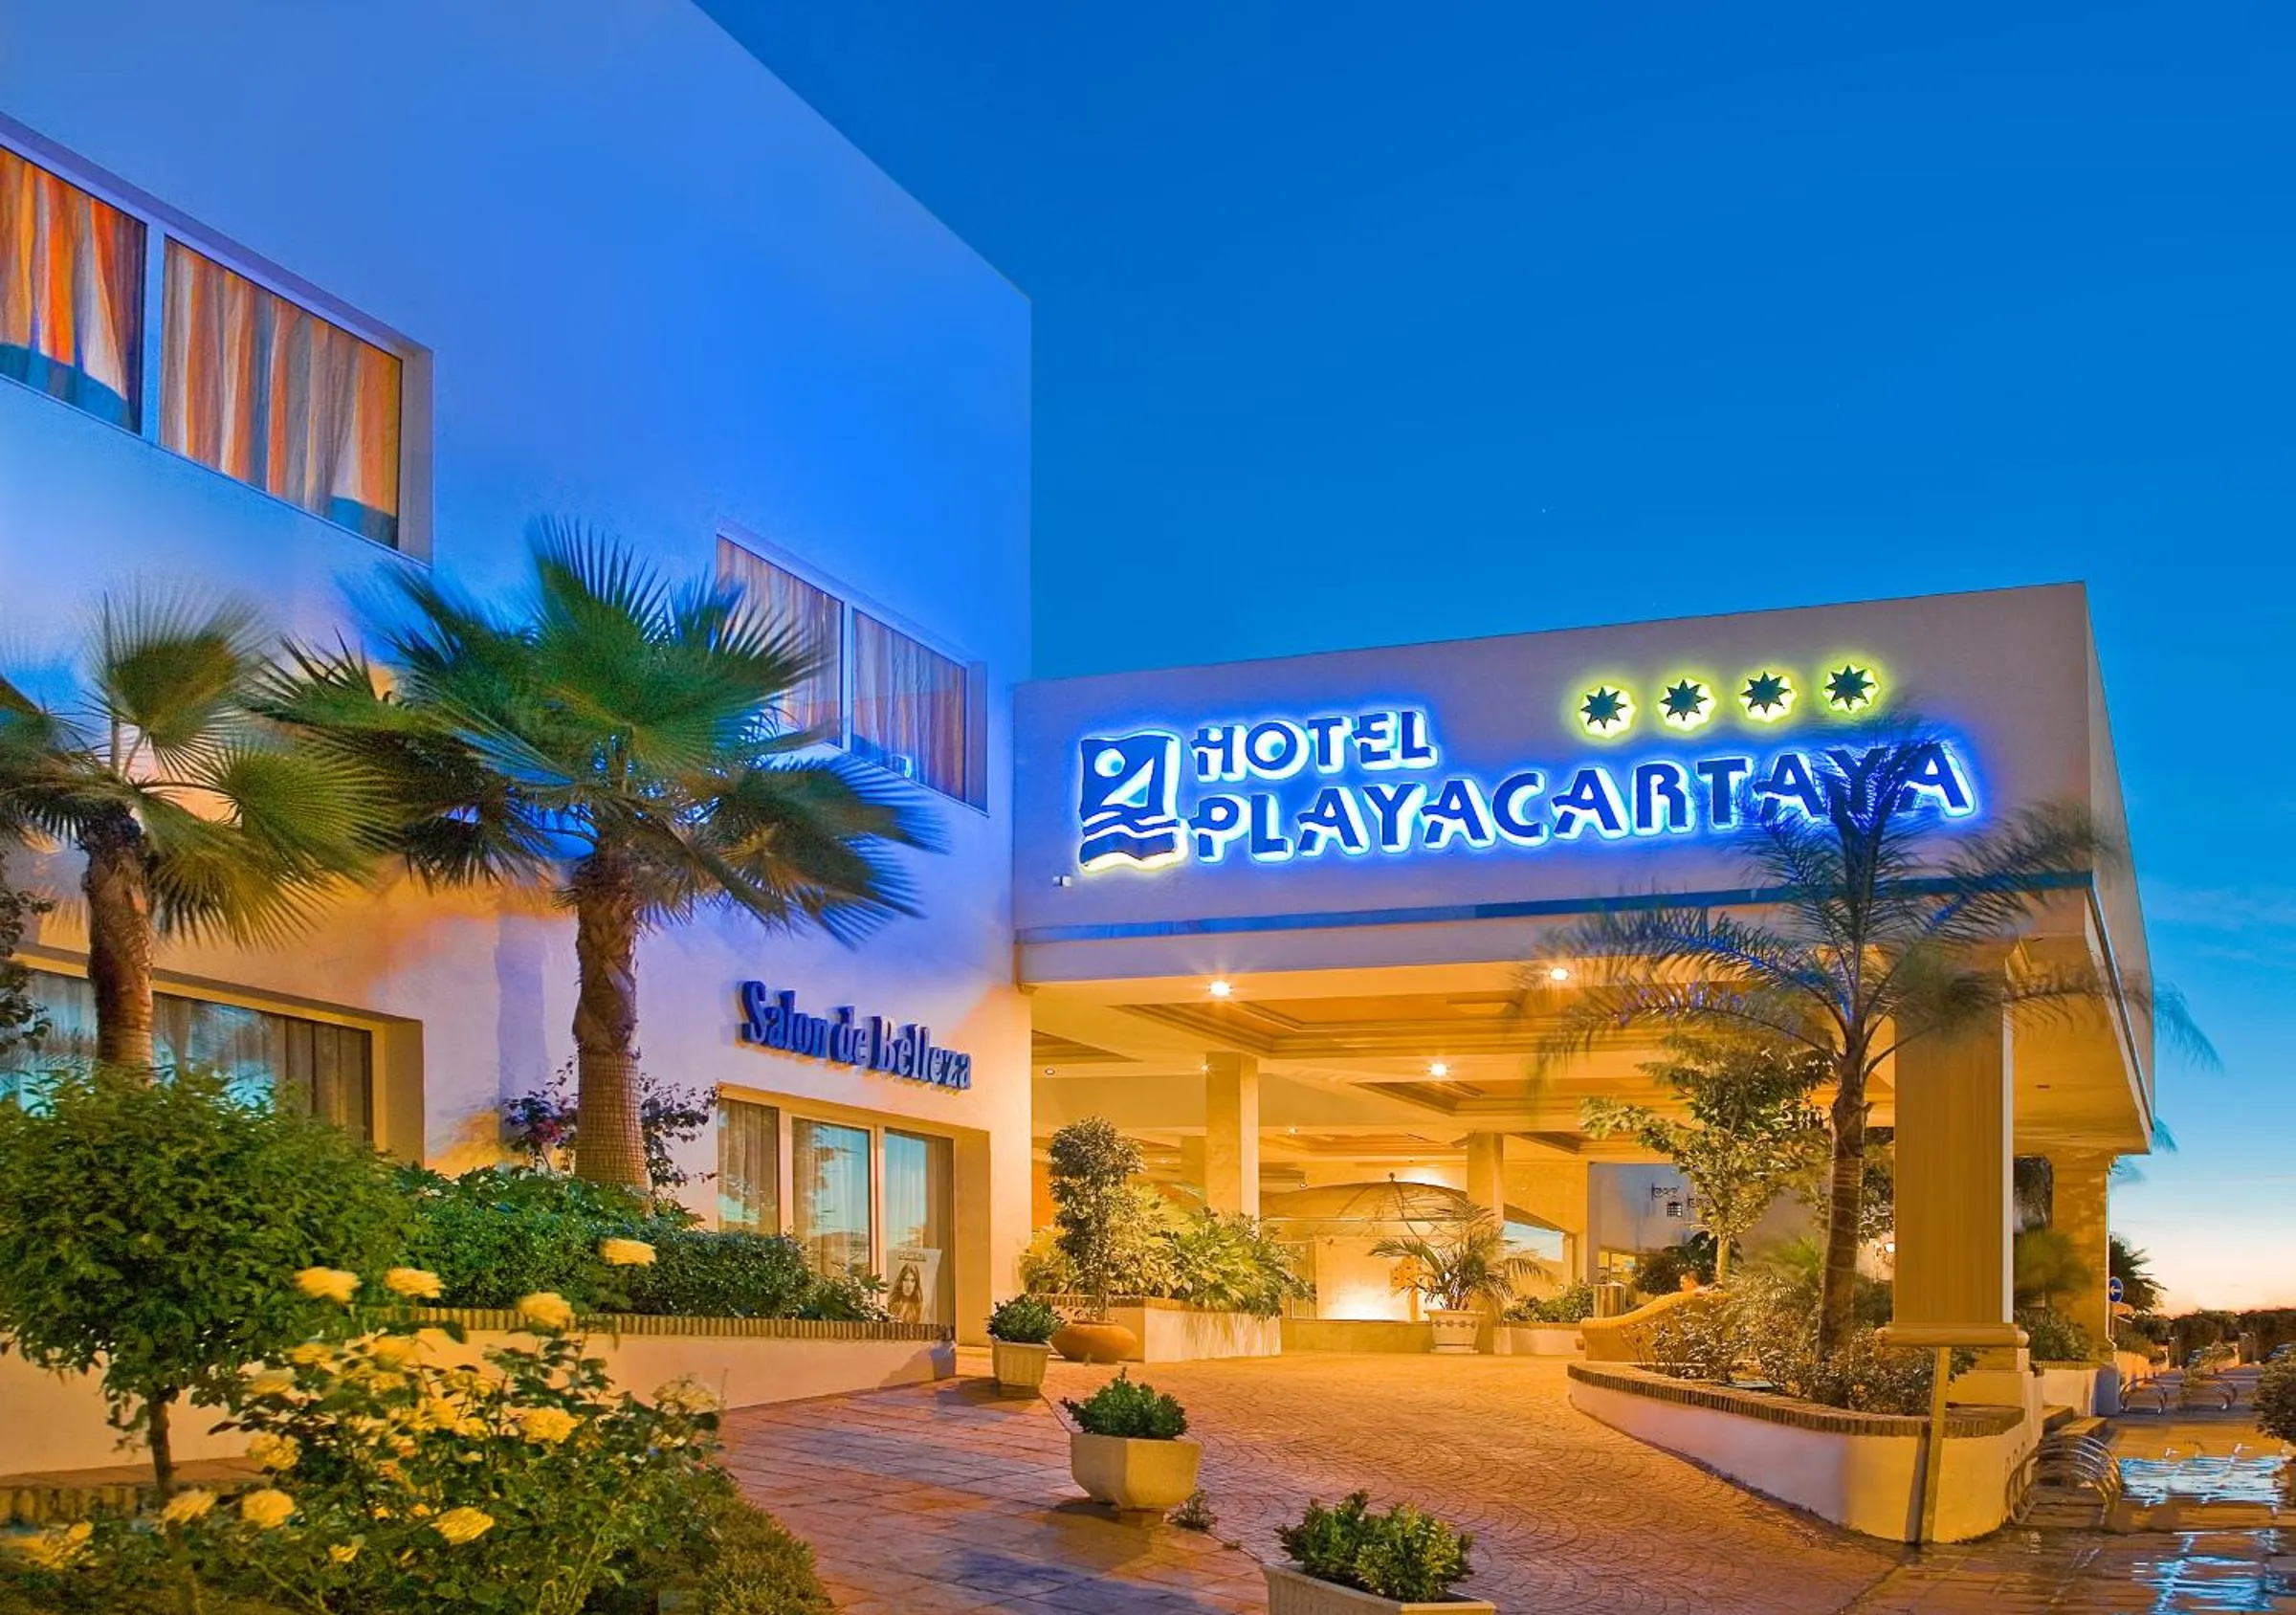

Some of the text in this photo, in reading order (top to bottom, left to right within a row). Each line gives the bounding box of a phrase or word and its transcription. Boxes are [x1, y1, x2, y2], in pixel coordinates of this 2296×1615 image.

[1189, 710, 1437, 781] HOTEL
[830, 1006, 870, 1066] de
[868, 1016, 971, 1090] Belleza
